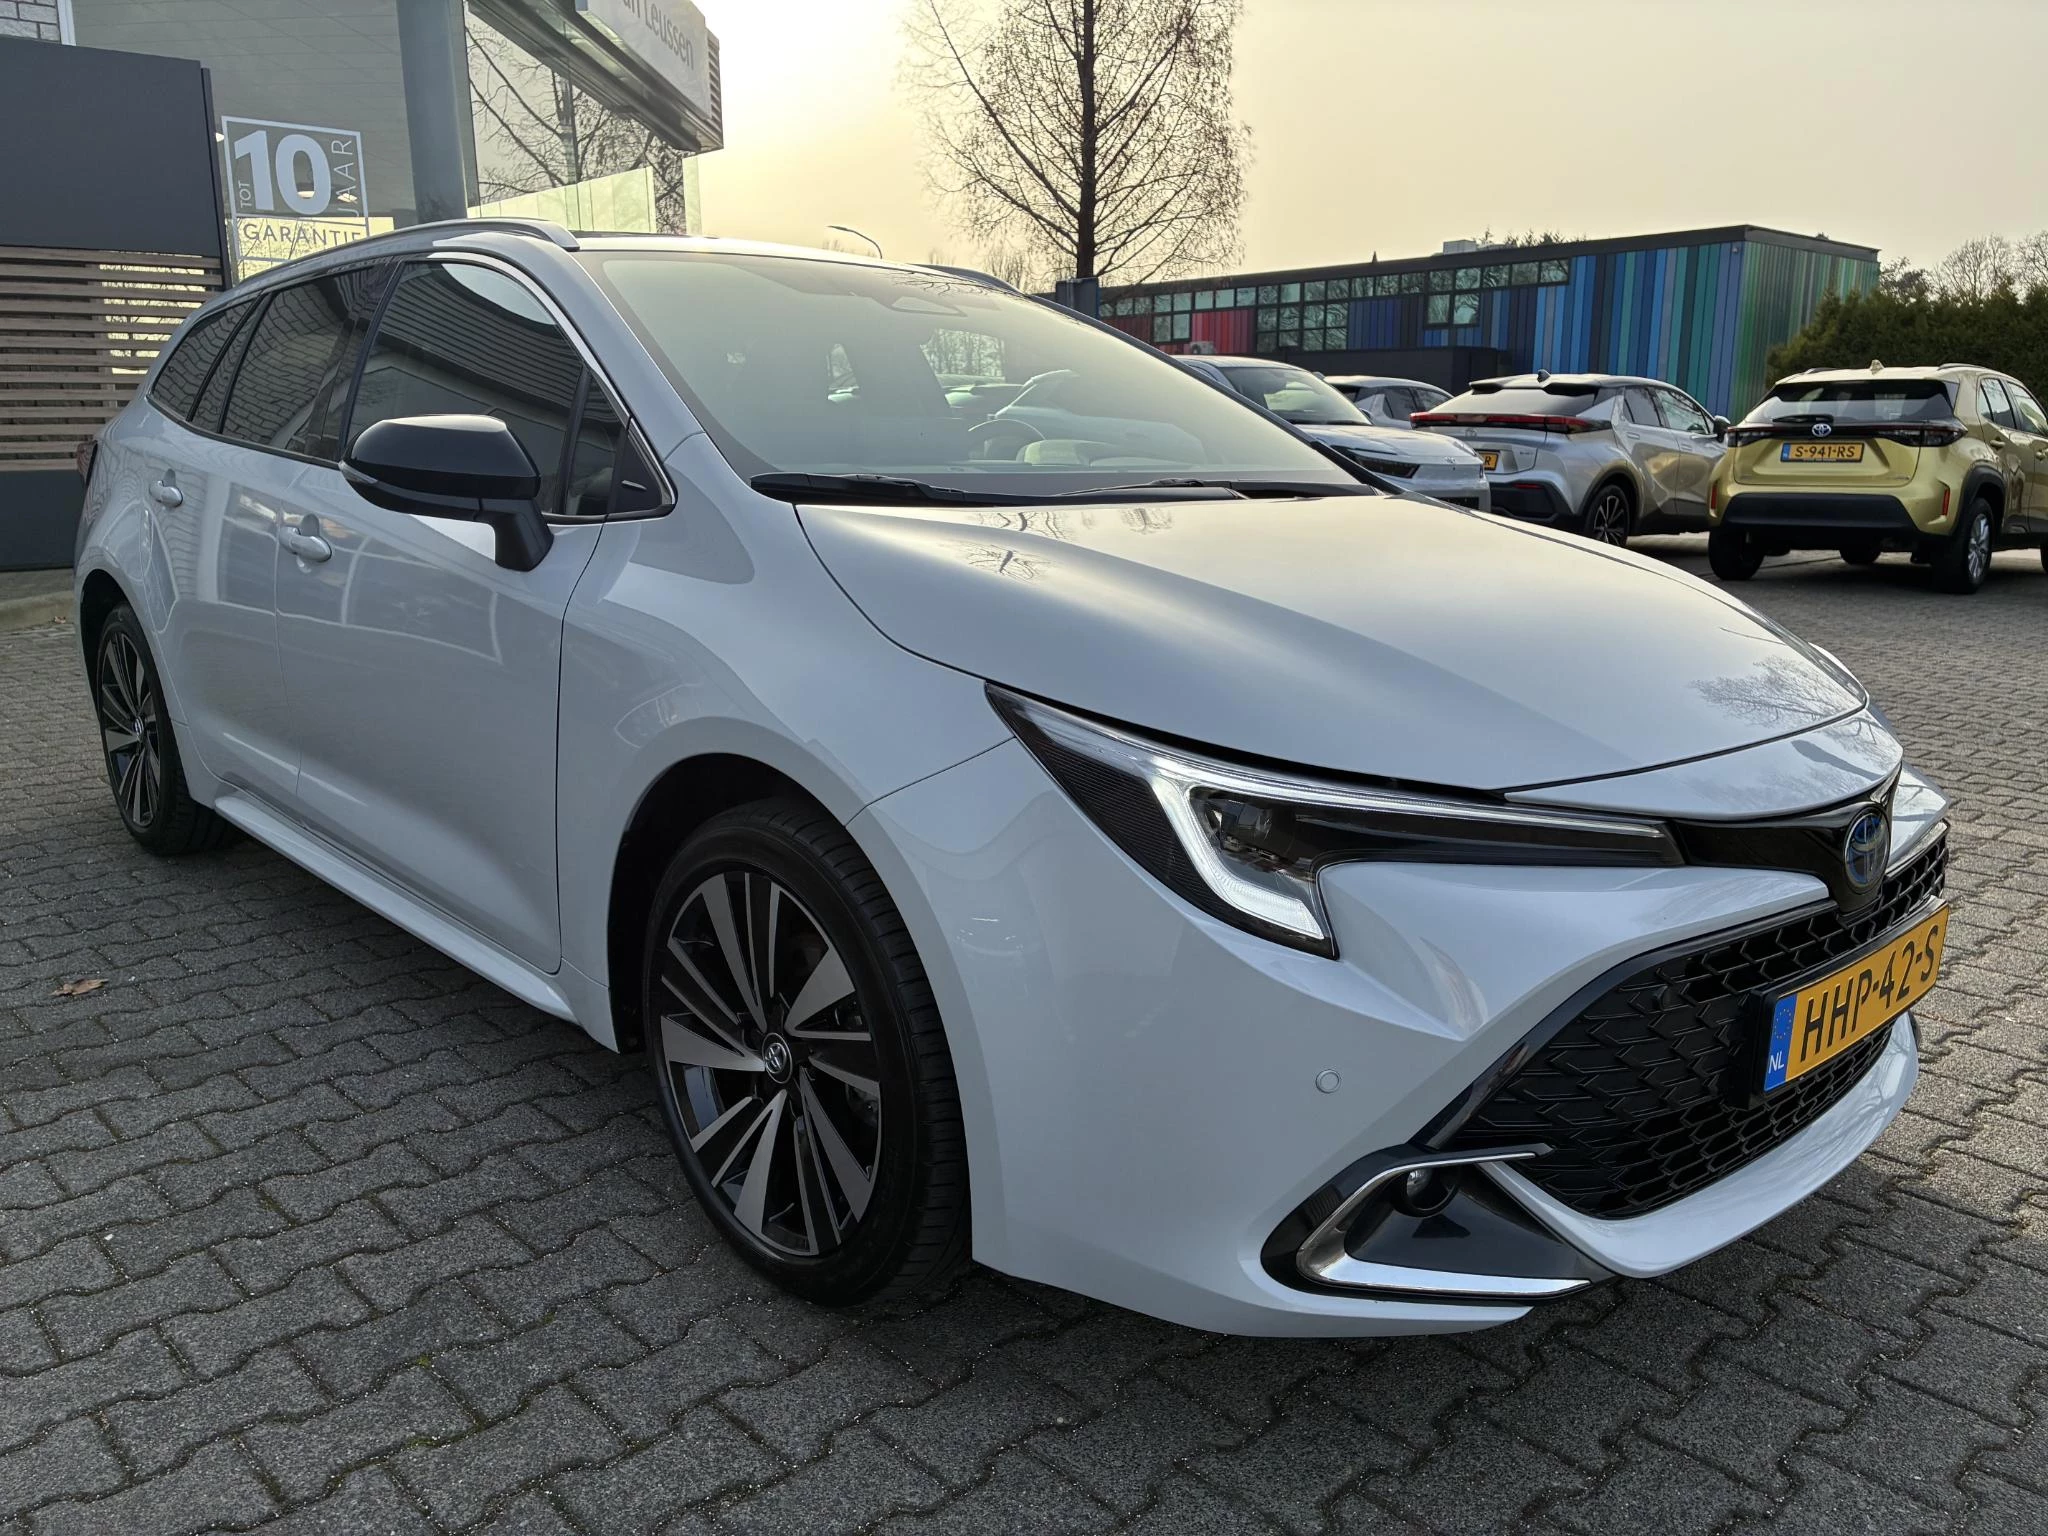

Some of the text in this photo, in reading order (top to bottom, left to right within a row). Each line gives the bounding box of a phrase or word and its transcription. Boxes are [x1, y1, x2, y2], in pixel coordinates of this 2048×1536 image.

[234, 130, 361, 217] TOT 10 JAAR
[1795, 446, 1855, 458] S-941-RS
[1801, 925, 1938, 1062] HHP-42-S
[1768, 1052, 1784, 1075] NL
